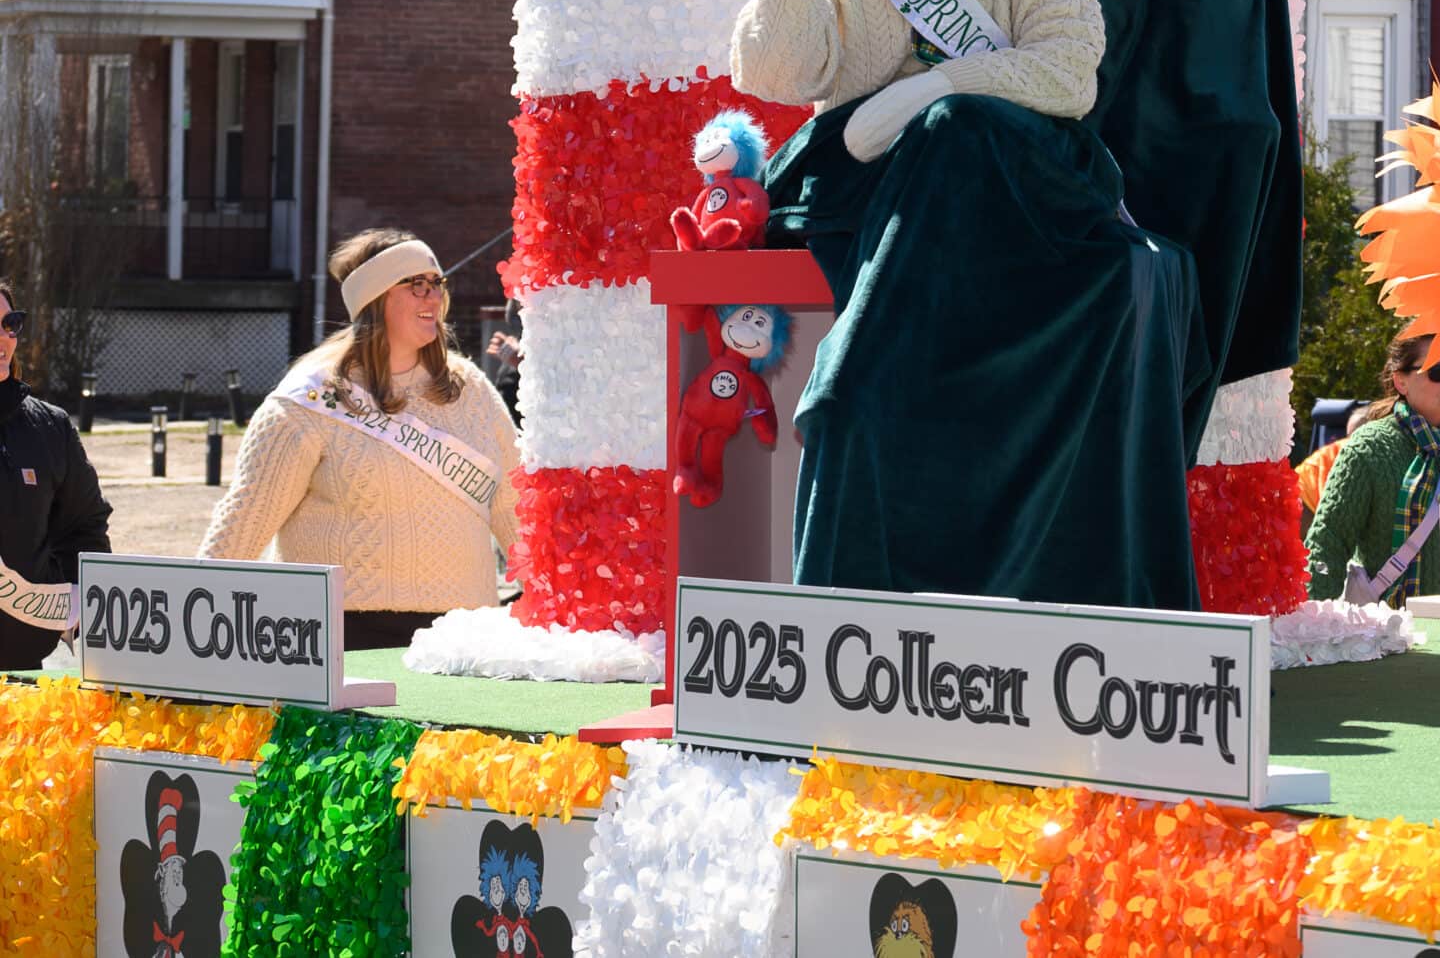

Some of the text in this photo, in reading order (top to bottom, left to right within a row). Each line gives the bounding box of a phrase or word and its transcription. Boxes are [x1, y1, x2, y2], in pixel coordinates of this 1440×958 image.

[344, 398, 496, 504] 2024 SPRINGFIELD
[86, 585, 323, 666] 2025 Colleen
[684, 616, 1241, 764] 2025 Colleen Court
